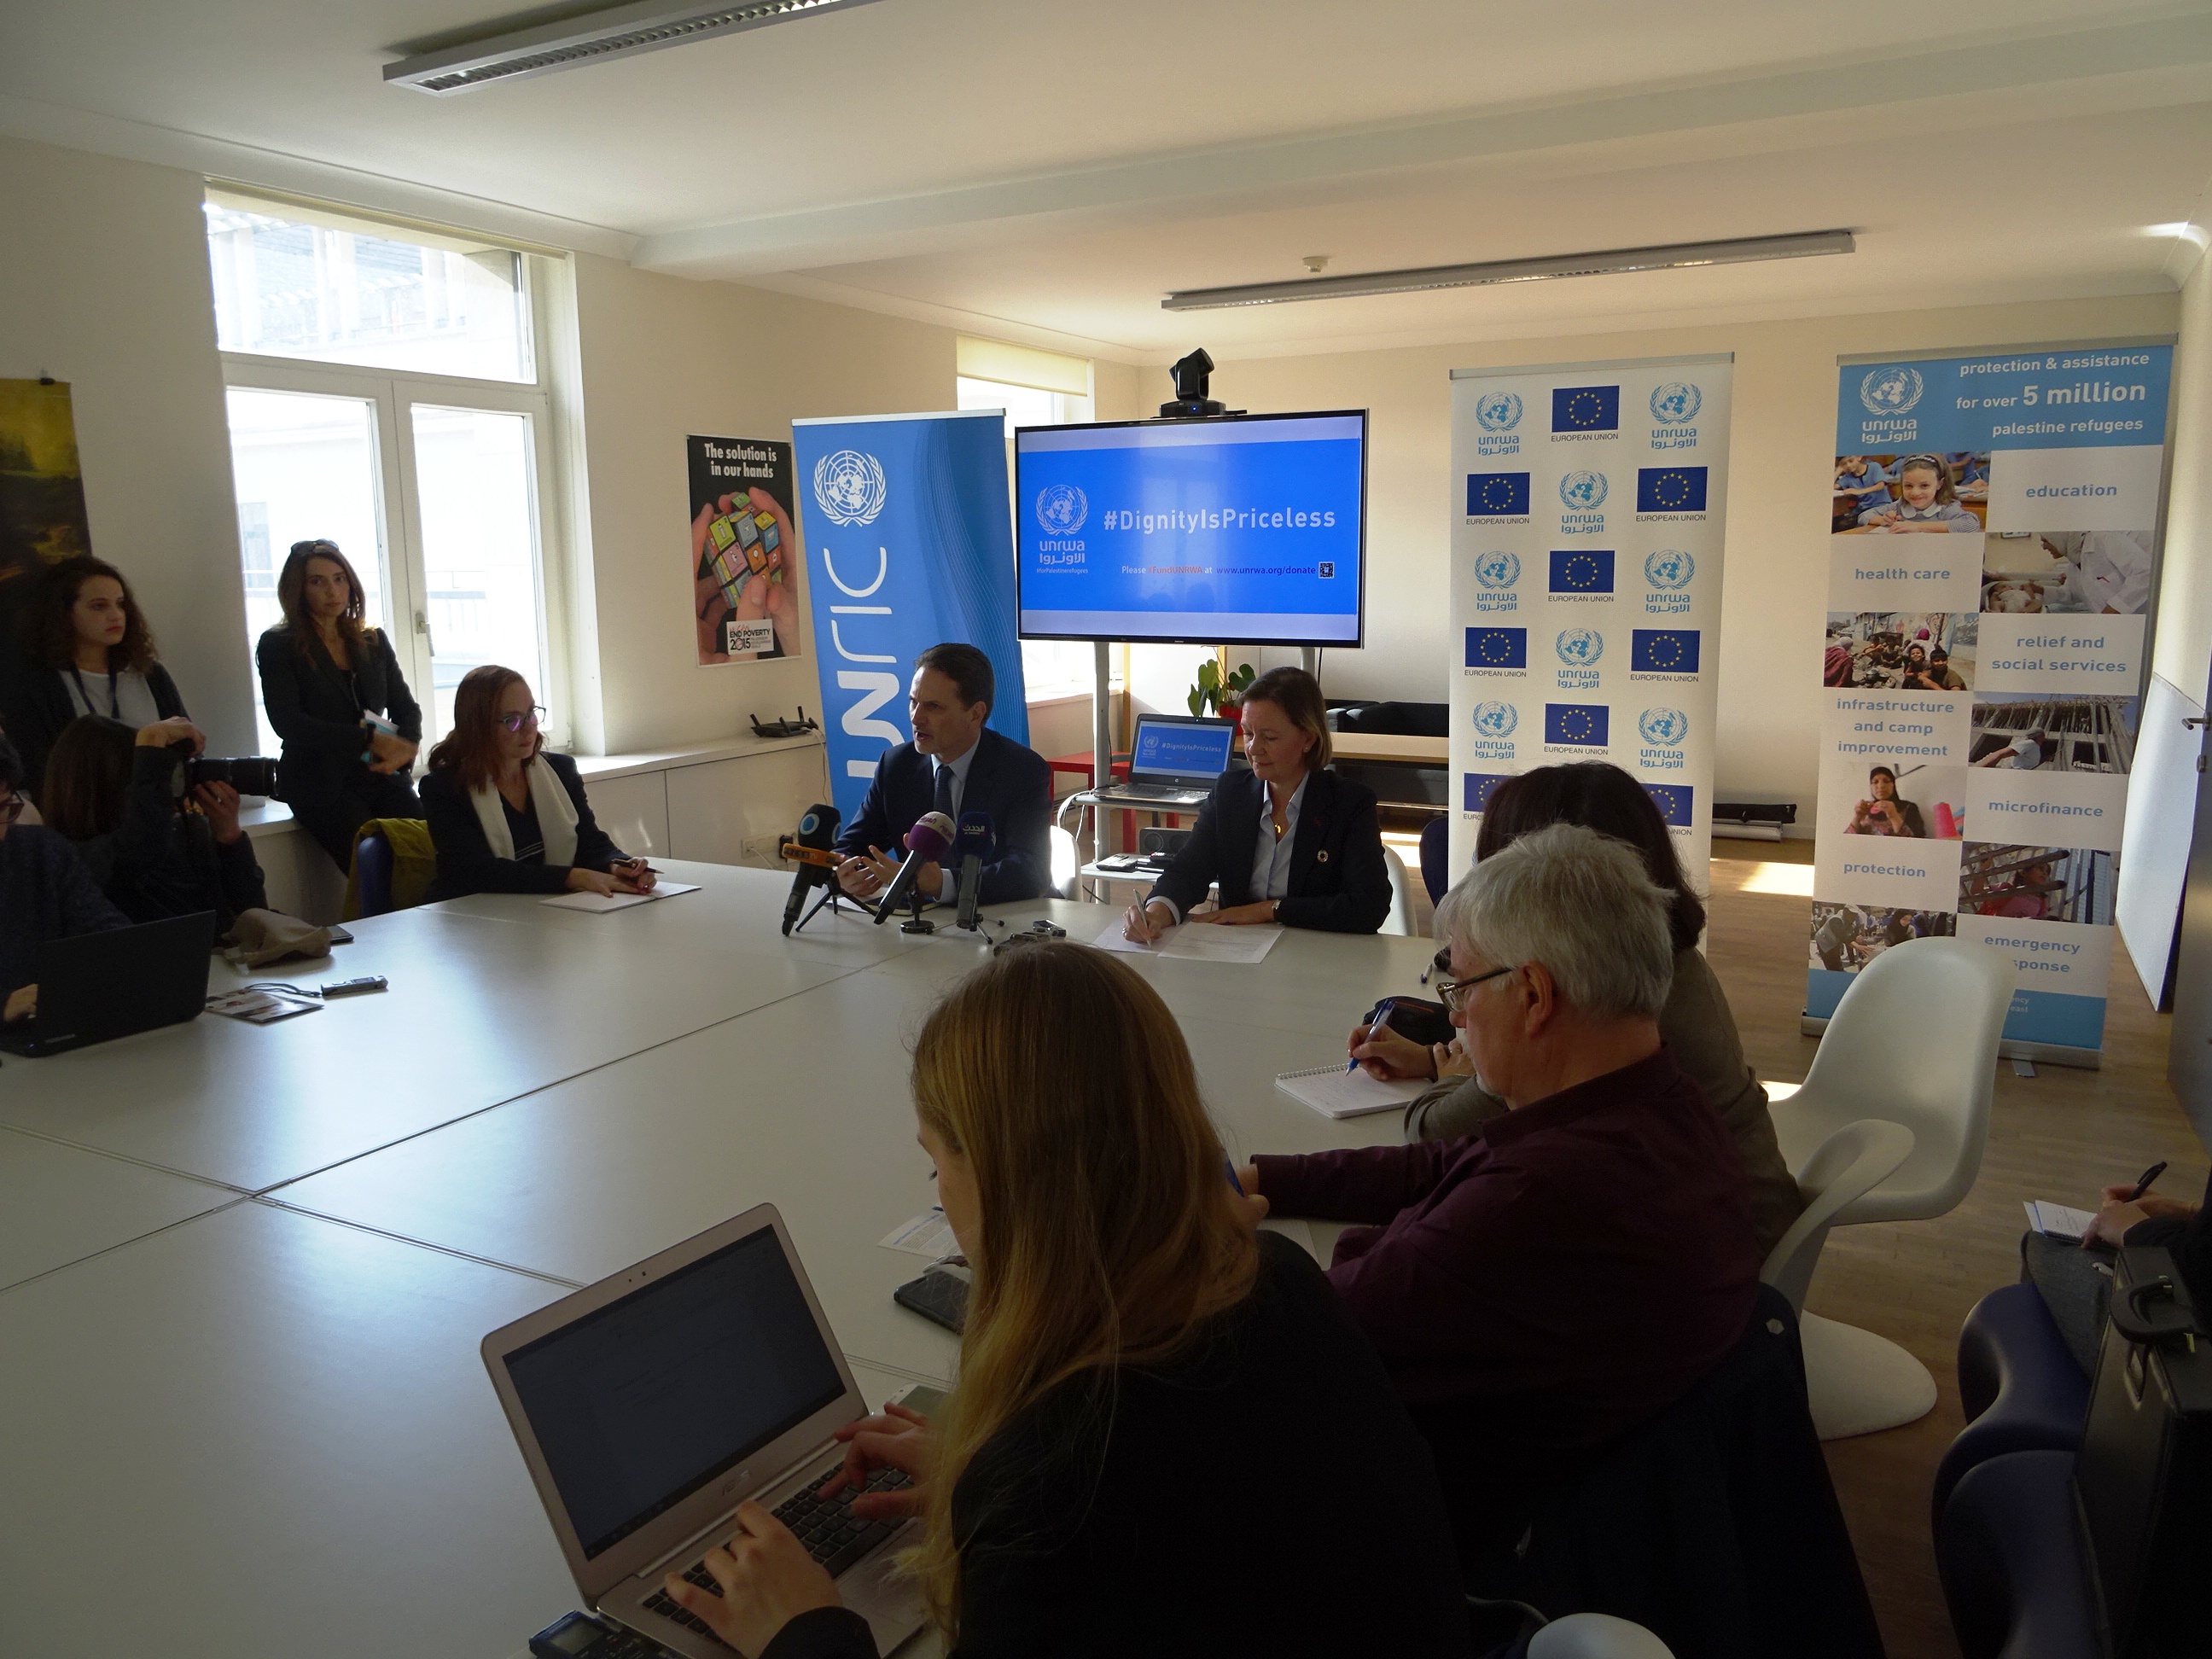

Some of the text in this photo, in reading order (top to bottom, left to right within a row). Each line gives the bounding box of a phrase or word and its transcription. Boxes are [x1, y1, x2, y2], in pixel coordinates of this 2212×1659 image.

[1959, 354, 2150, 377] protection & assistance
[1956, 381, 2146, 409] for over 5 million
[1862, 419, 1918, 431] unrwa
[1993, 418, 2144, 438] palestine refugees
[1478, 435, 1520, 445] unrwa
[1551, 434, 1592, 442] EUROPEAN
[1652, 428, 1697, 439] unrwa
[704, 442, 777, 462] The solution is
[711, 460, 774, 478] in our hands
[2025, 484, 2117, 498] education
[1103, 507, 1336, 534] #DignityIsPriceless
[1561, 515, 1604, 523] unrwa
[1039, 540, 1086, 551] unrwa
[1121, 565, 1146, 574] Please
[1148, 566, 1202, 574] #FundUNRWA
[1216, 565, 1316, 576] www.unrwa.org/donate
[1854, 568, 1951, 580] health care
[1476, 592, 1517, 602] unrwa
[1645, 593, 1691, 602] unrwa
[743, 628, 771, 637] POVERTY
[730, 637, 751, 650] 2015
[2017, 636, 2104, 649] relief and
[1992, 658, 2127, 672] social services
[1557, 670, 1600, 679] unrwa
[1837, 698, 1954, 713] infrastructure
[1854, 721, 1933, 736] and camp
[1475, 741, 1515, 750] unrwa
[1544, 746, 1583, 754] EUROPEAN
[1837, 740, 1947, 757] improvement
[1640, 748, 1684, 759] unrwa
[1988, 800, 2104, 817] microfinance
[1843, 862, 1926, 878] protection
[1984, 936, 2081, 955] emergency
